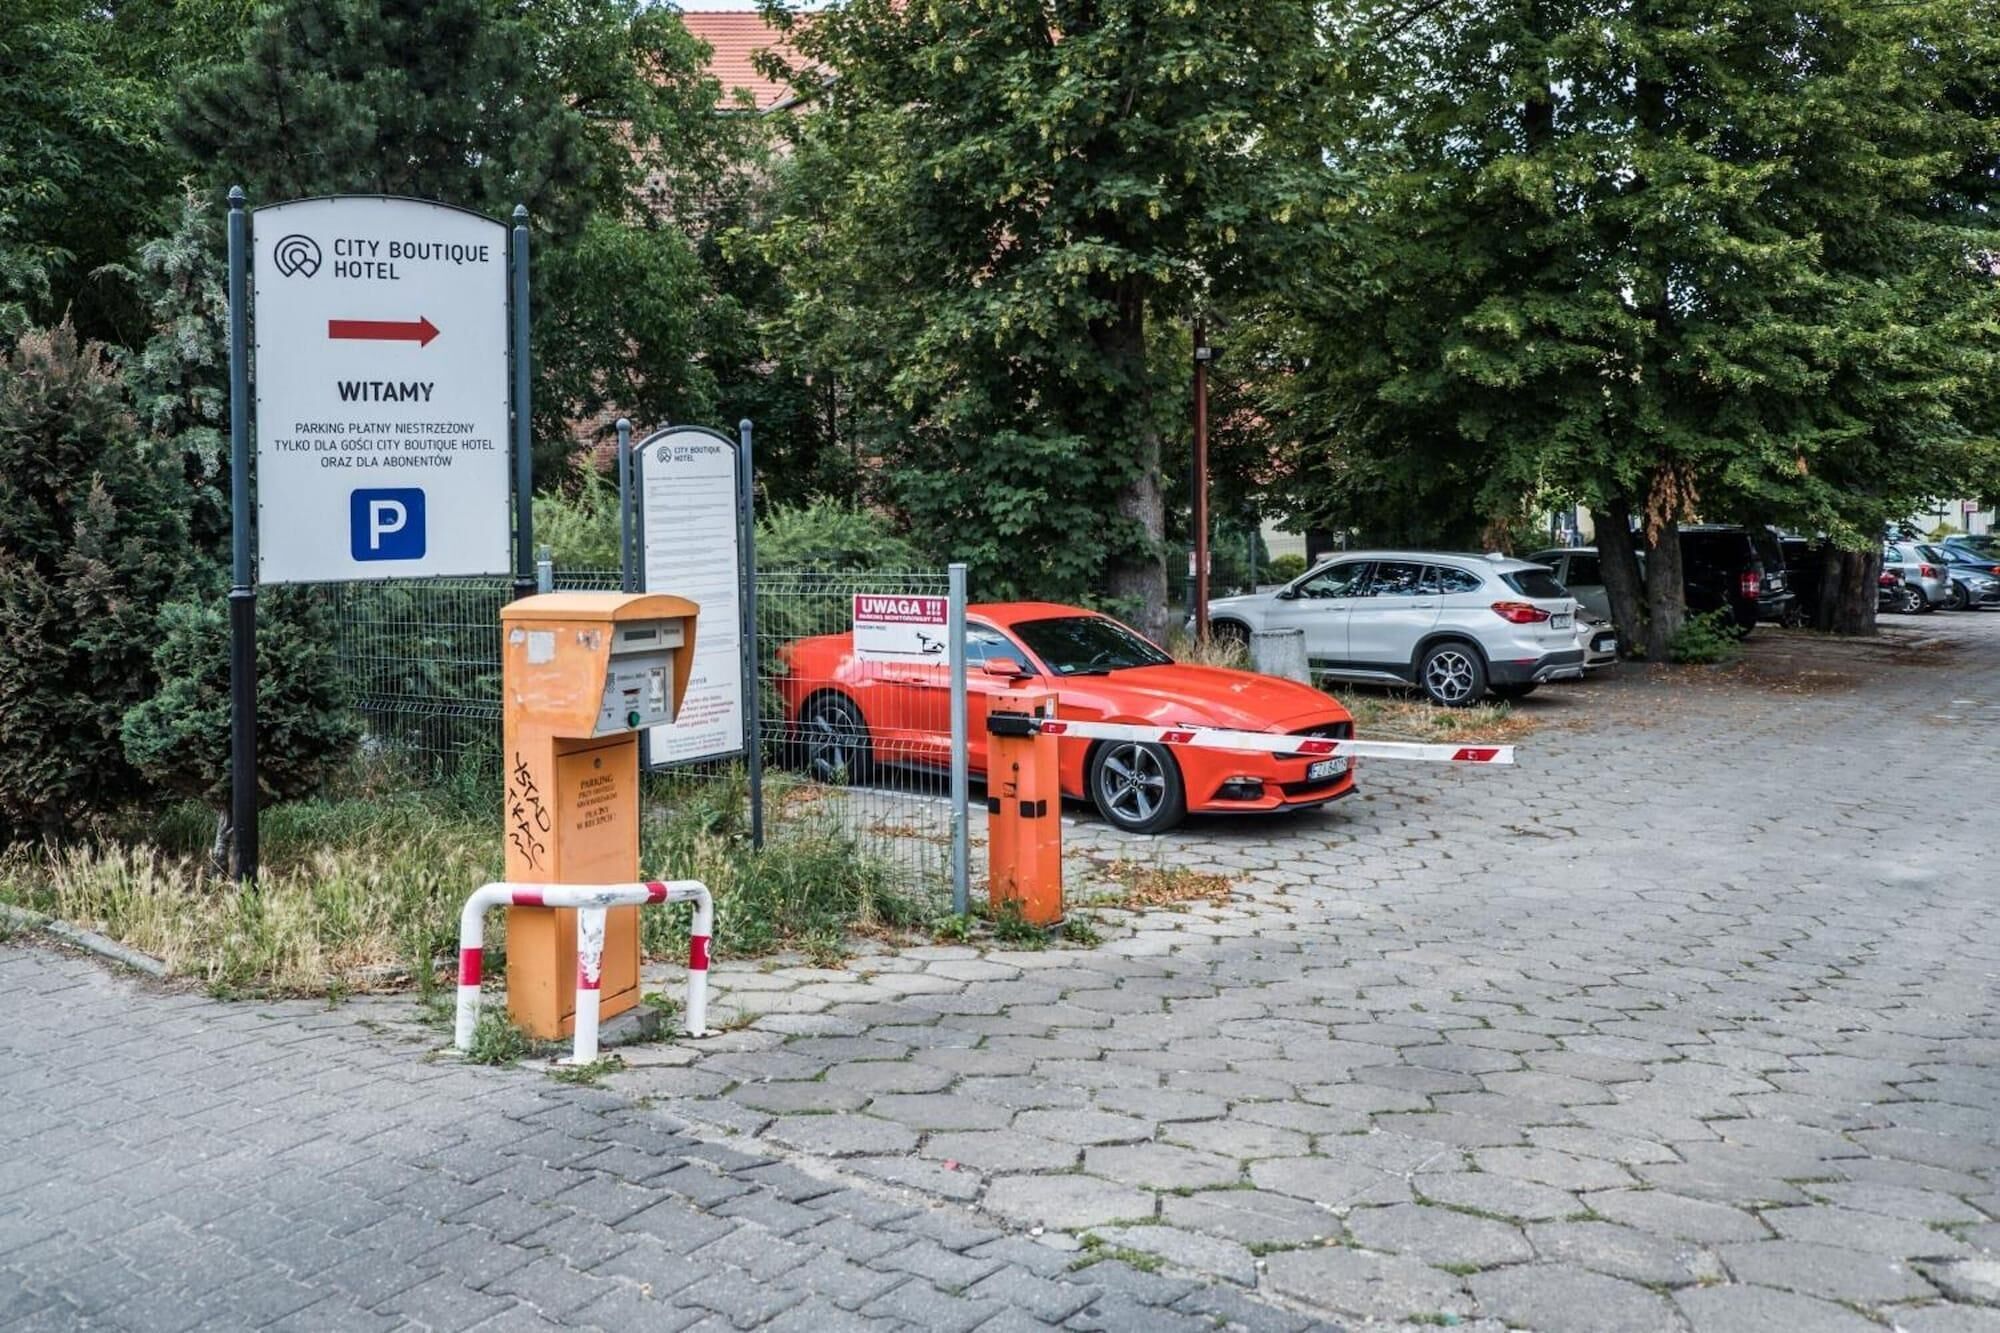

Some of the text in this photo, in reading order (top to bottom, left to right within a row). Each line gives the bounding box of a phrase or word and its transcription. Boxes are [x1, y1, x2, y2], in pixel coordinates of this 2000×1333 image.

[334, 239, 489, 265] CITY BOUTIQUE
[334, 260, 400, 280] HOTEL
[337, 381, 435, 403] WITAMY
[295, 423, 345, 434] PARKING
[349, 423, 391, 434] PŁATNY
[274, 437, 495, 453] TYLKO DLA GOŚCI CITY BOUTIQUE HOTEL
[690, 446, 721, 455] BOUTIQUE
[320, 454, 453, 468] ORAZ DLA ABONENTÓW
[369, 500, 408, 550] P
[861, 598, 941, 616] UWAGA !!!
[580, 775, 614, 790] PARKING
